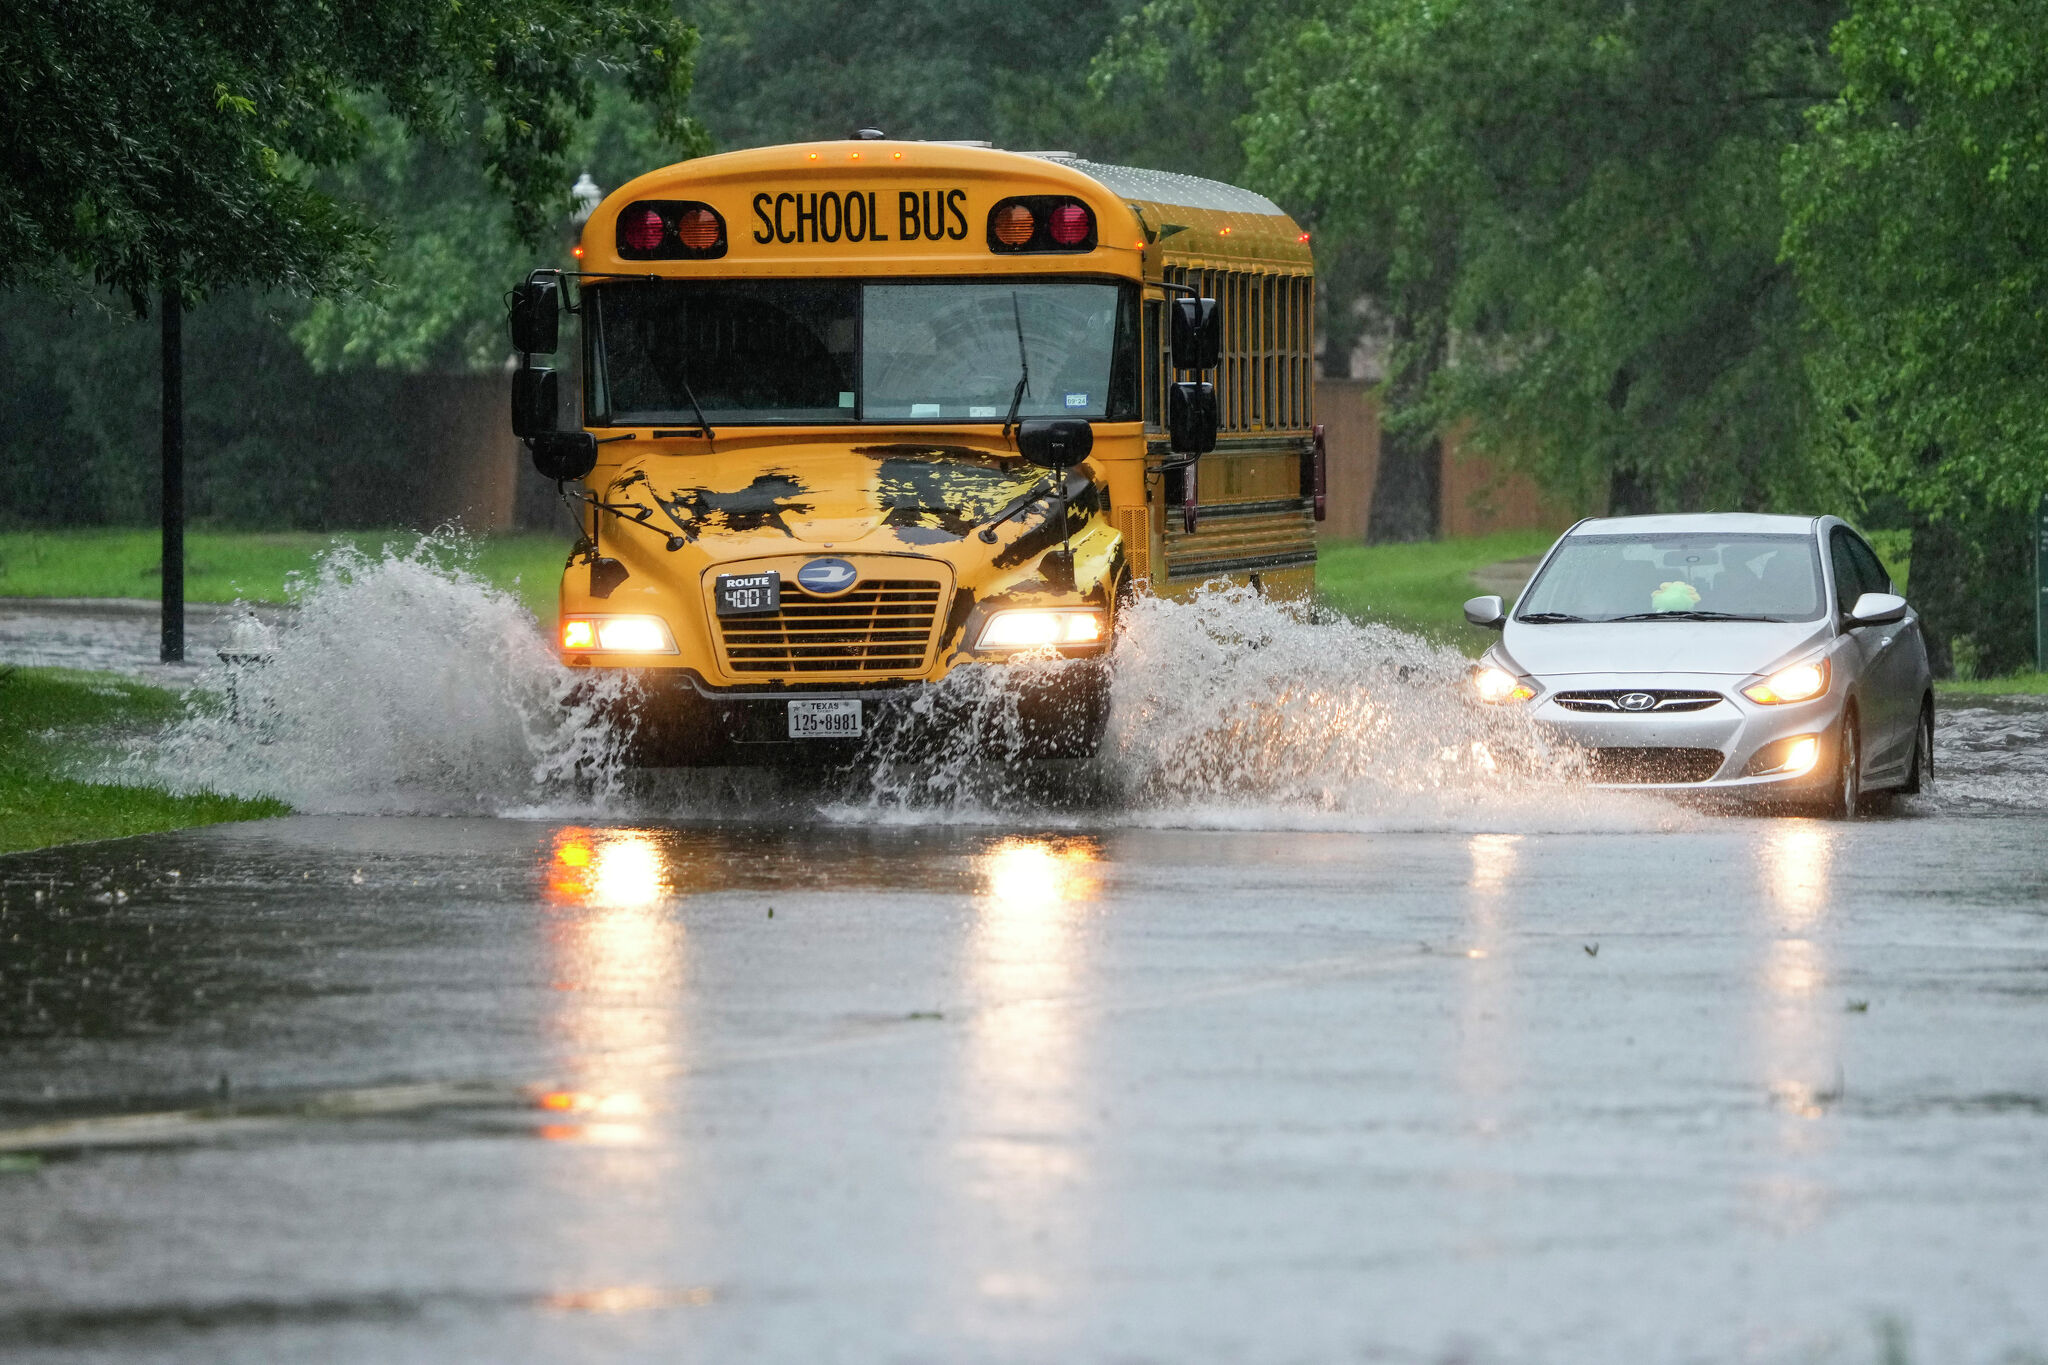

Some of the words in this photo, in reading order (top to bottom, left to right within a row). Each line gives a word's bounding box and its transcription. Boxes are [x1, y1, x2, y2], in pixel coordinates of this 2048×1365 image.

[753, 191, 888, 244] SCHOOL
[899, 189, 968, 240] BUS
[726, 577, 769, 588] ROUTE
[725, 589, 771, 608] 4001
